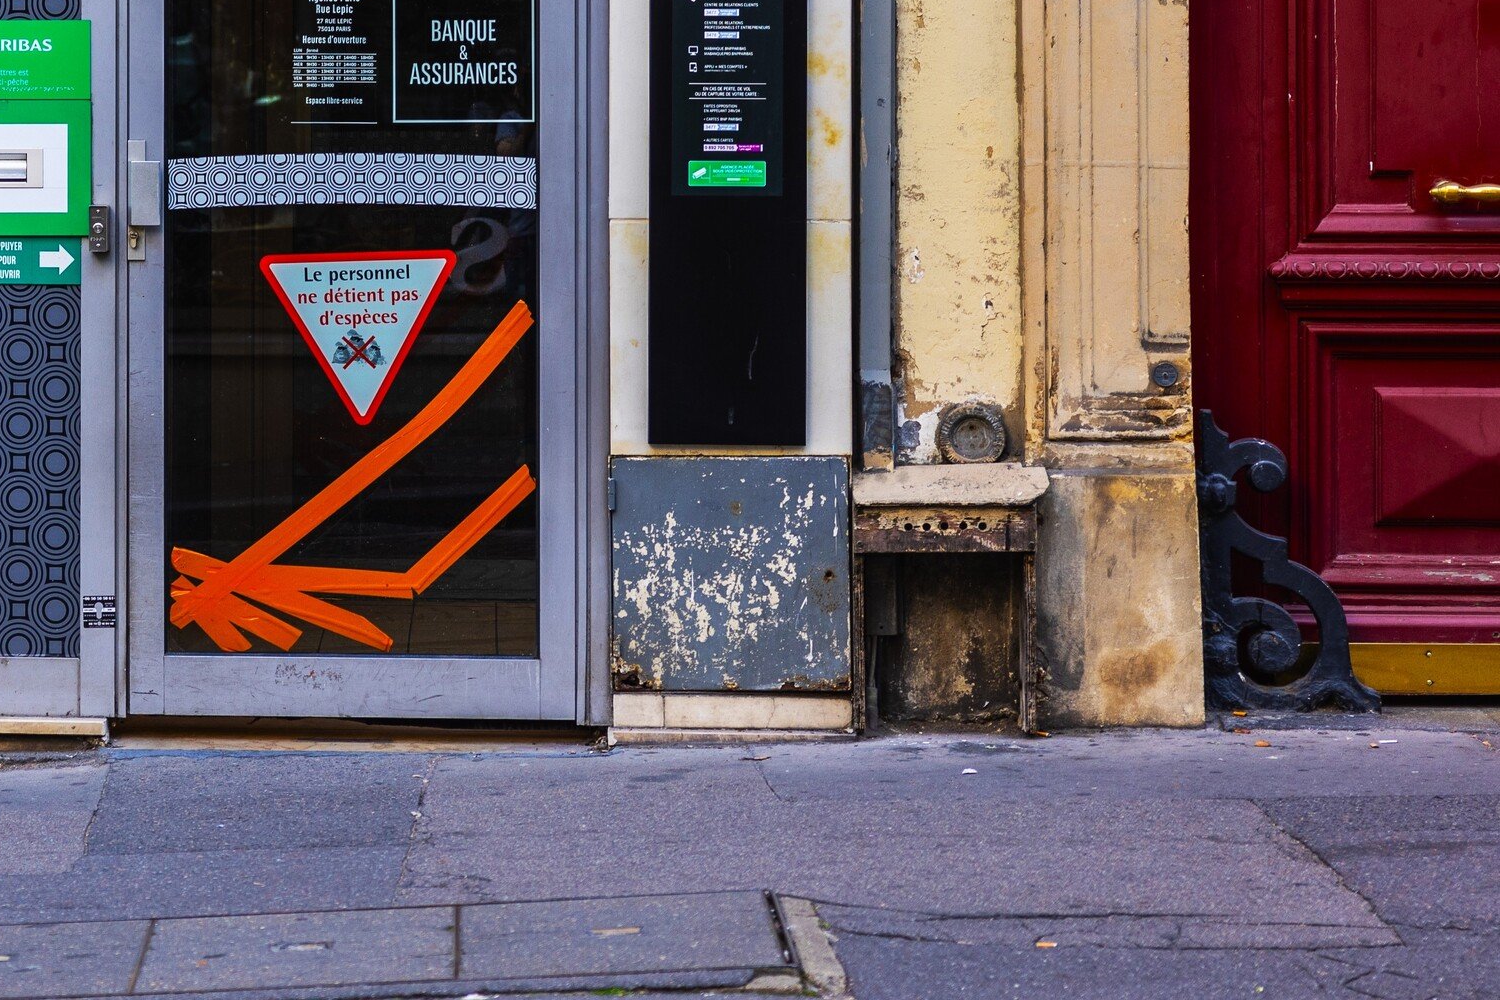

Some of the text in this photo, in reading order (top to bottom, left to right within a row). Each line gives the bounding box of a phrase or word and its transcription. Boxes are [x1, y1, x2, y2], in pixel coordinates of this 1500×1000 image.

[316, 4, 353, 15] Rue Lepic
[303, 35, 366, 44] Heures d'ouverture
[431, 20, 496, 44] BANQUE
[459, 45, 468, 60] &
[410, 63, 518, 85] ASSURANCES
[306, 97, 325, 105] Espace
[304, 265, 410, 285] Le personnel
[298, 288, 418, 305] ne détient pas
[320, 310, 398, 328] d'espèces
